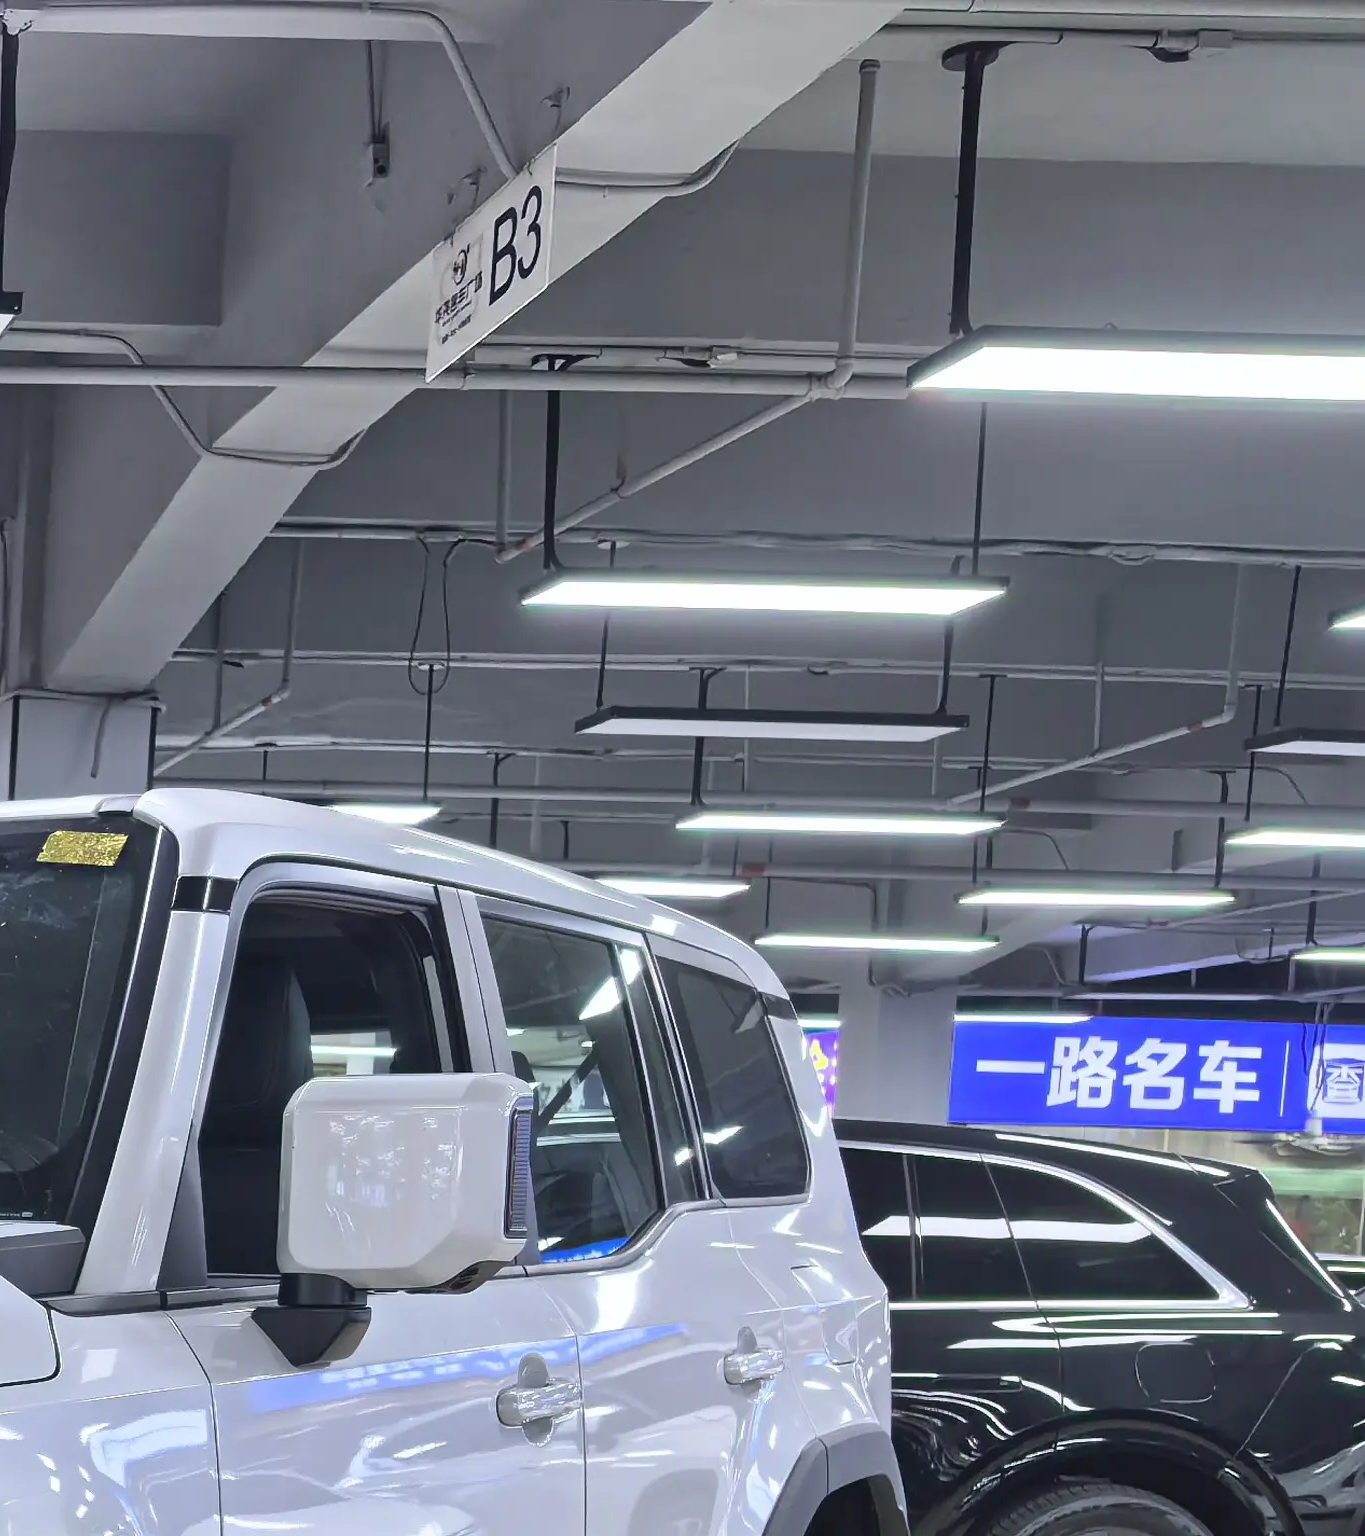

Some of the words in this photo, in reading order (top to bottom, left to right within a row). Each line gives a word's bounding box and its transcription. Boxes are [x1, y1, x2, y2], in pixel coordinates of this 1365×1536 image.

[488, 184, 543, 306] B3
[975, 1035, 1263, 1115] 一路名车
